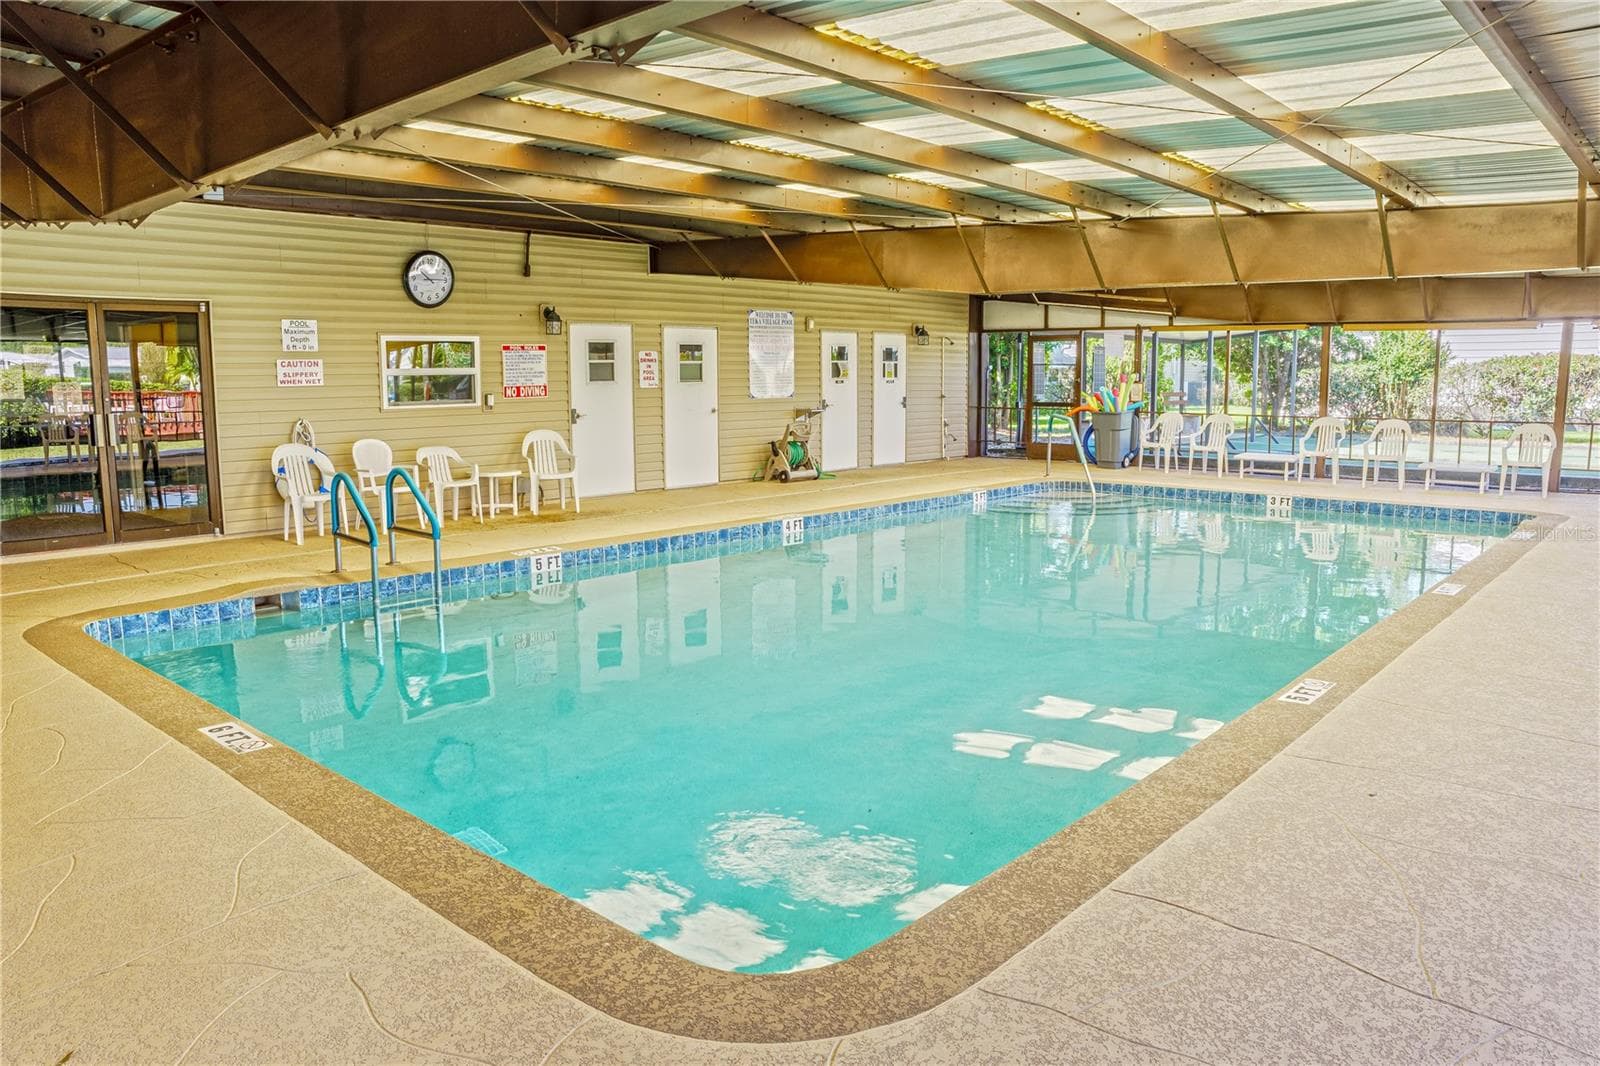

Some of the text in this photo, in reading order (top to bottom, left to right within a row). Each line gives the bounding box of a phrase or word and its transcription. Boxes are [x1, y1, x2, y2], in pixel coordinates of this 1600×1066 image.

[505, 386, 545, 397] NO DIVING
[1270, 496, 1276, 506] 3
[786, 520, 790, 531] 4
[536, 558, 542, 570] 5
[208, 725, 234, 733] 6
